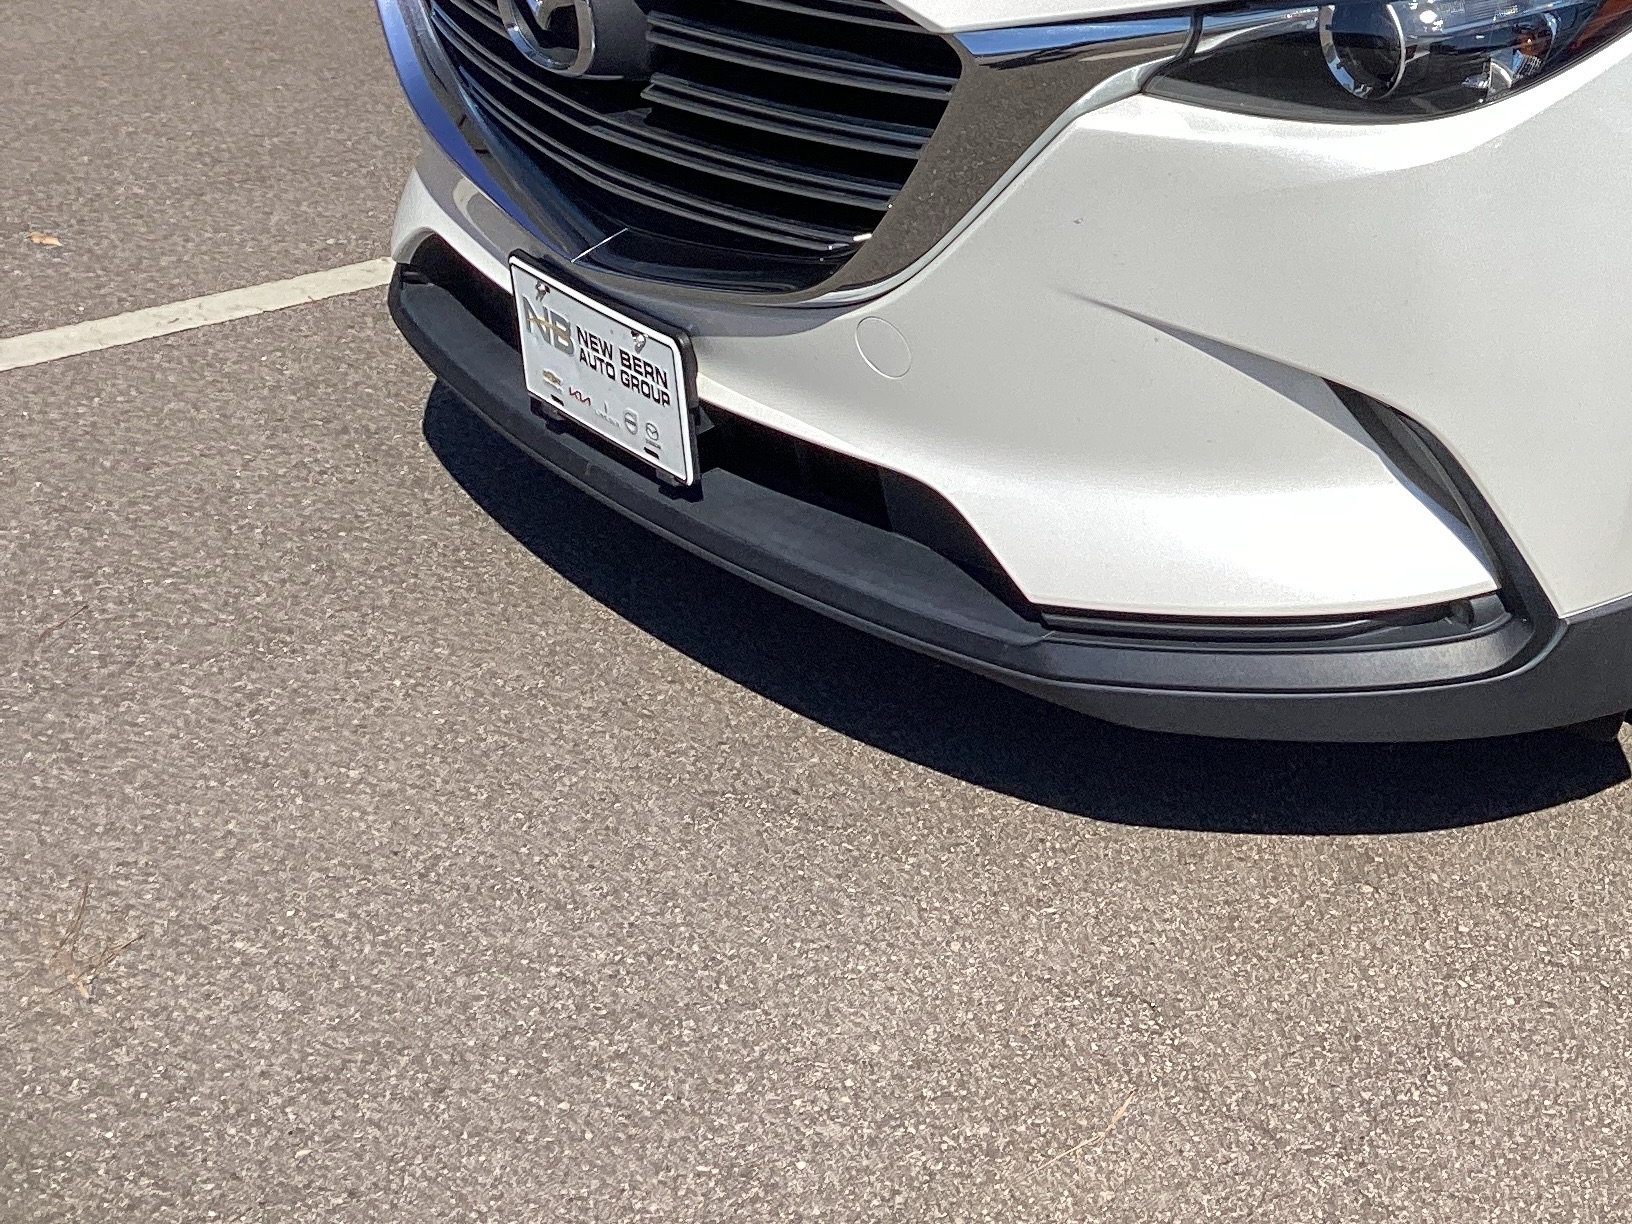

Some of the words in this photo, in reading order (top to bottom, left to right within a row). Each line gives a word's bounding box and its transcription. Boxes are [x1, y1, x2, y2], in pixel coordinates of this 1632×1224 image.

[522, 295, 575, 356] NB
[576, 325, 614, 361] NEW
[619, 348, 669, 390] BERN
[579, 348, 616, 382] AUTO
[620, 372, 671, 407] GROUP
